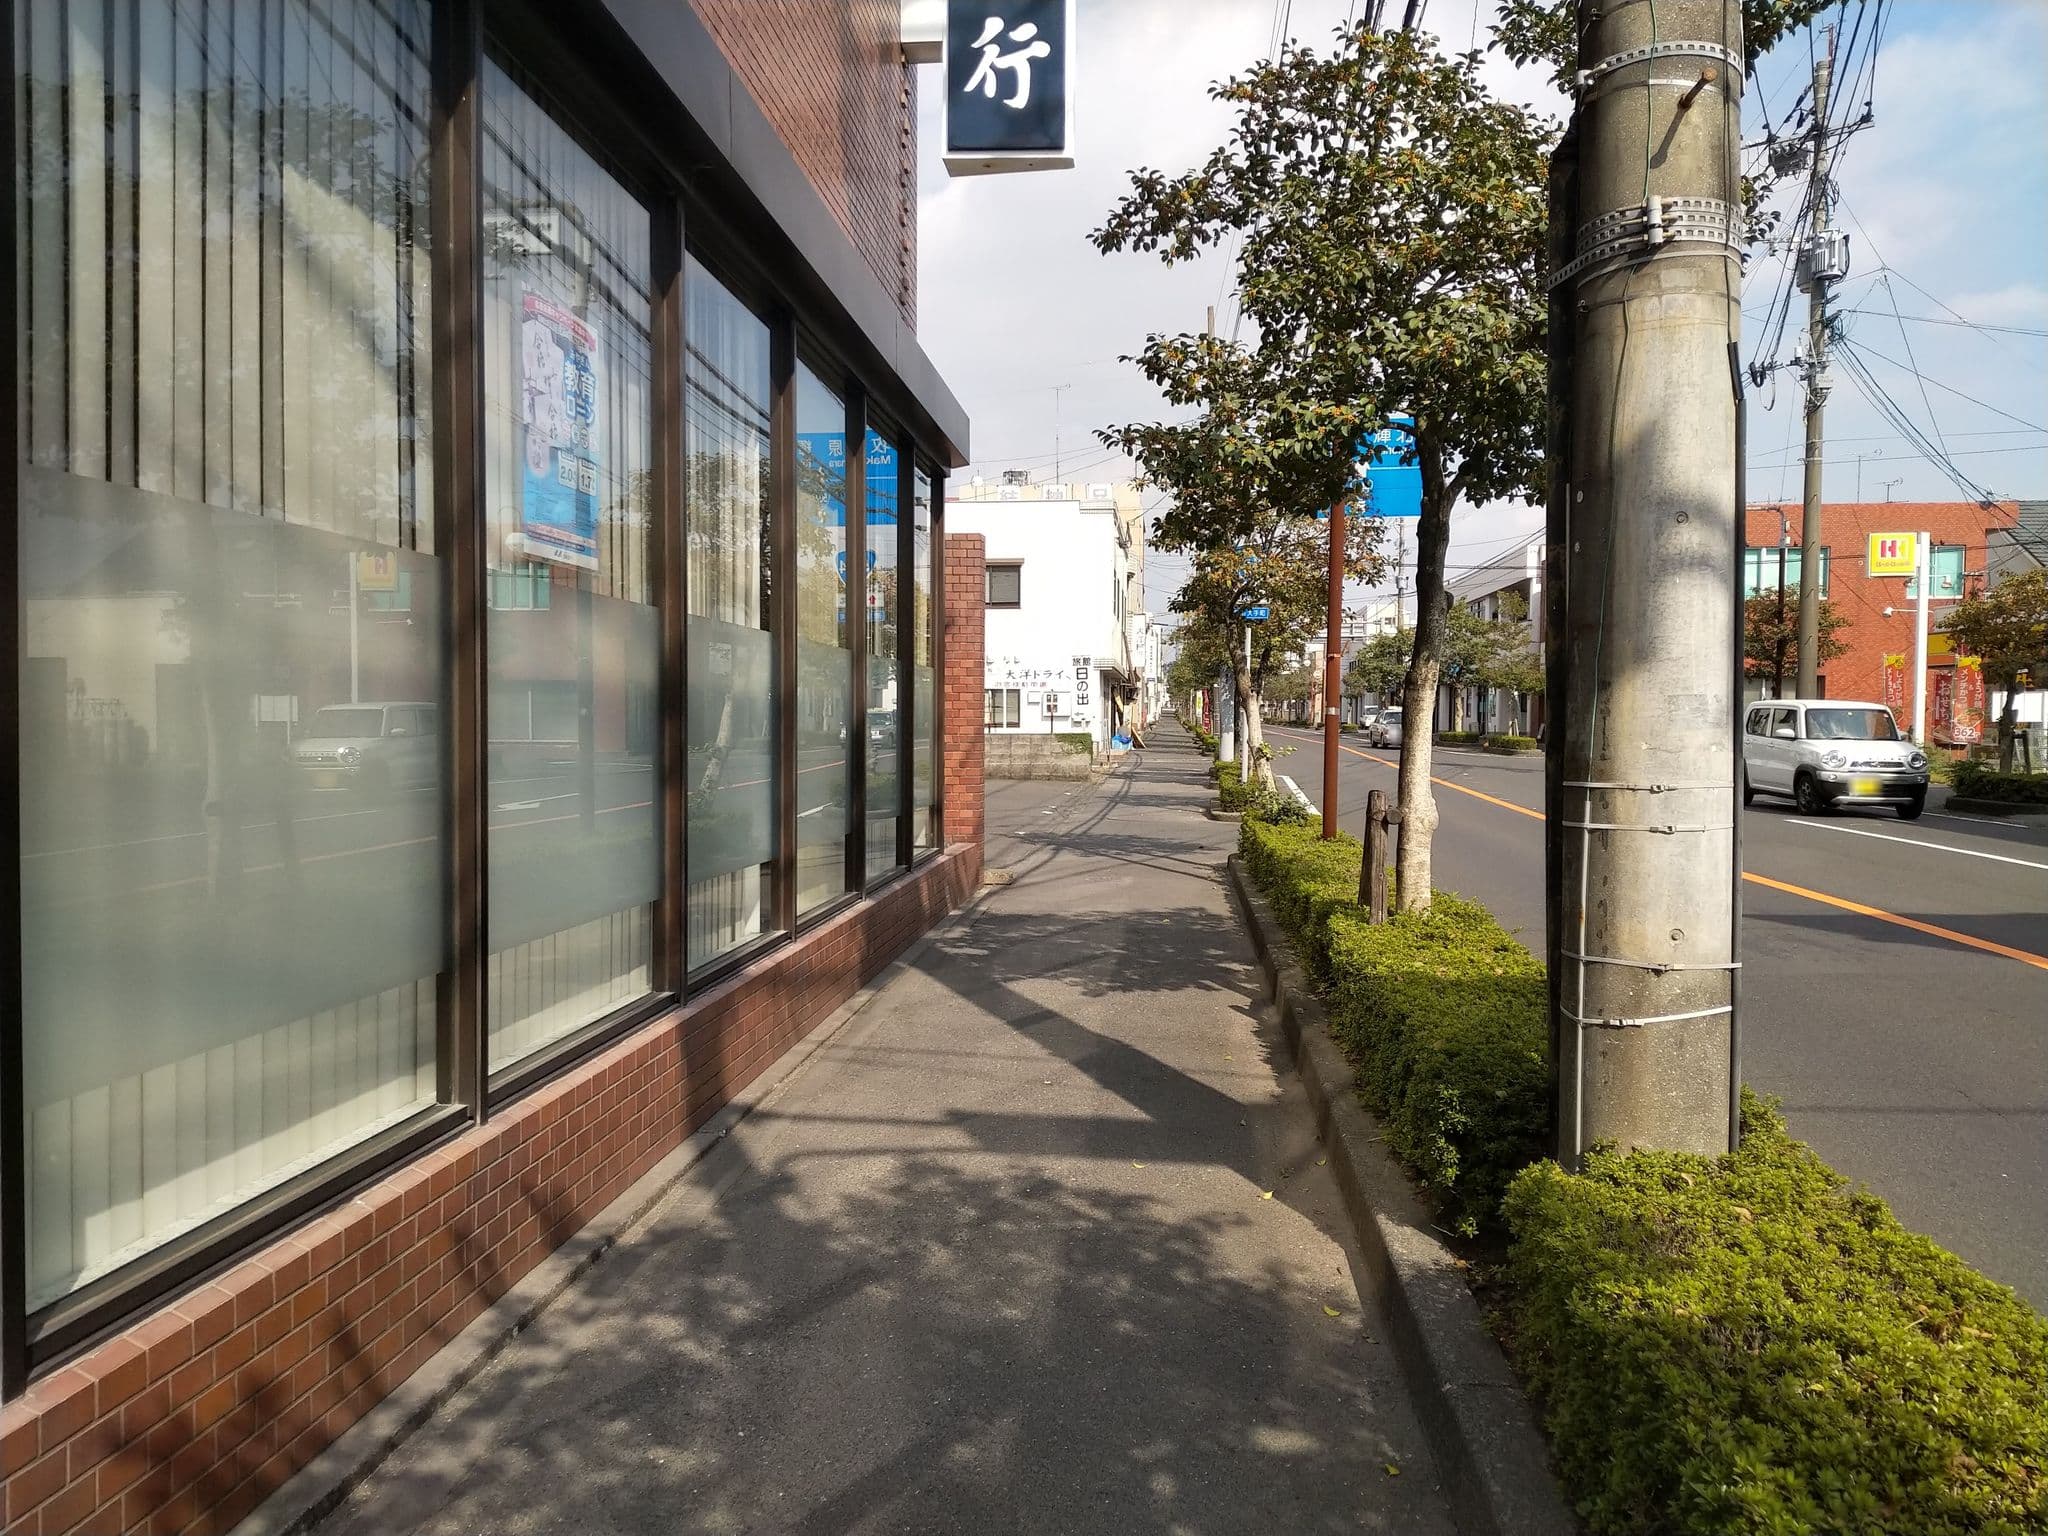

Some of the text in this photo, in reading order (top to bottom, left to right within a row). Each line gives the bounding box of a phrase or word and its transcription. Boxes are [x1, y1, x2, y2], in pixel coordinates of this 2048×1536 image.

[963, 16, 1051, 109] 行
[1076, 667, 1089, 706] 日の出
[1954, 727, 1975, 737] 362
